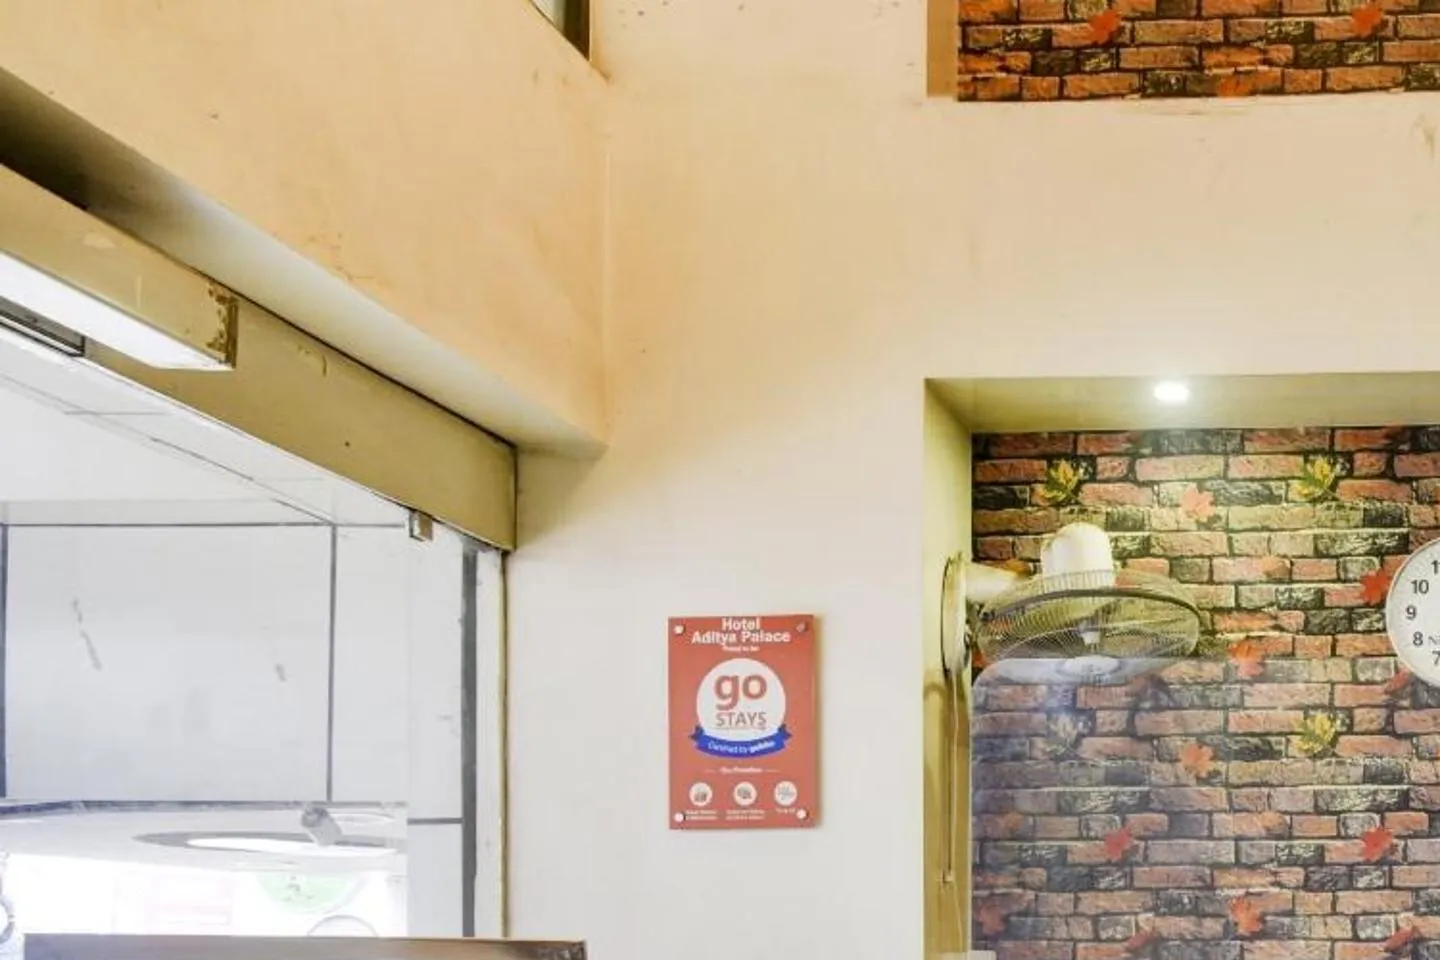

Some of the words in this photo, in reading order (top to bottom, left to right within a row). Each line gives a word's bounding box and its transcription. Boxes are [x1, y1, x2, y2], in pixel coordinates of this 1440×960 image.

[1412, 579, 1429, 594] 10
[1406, 605, 1417, 620] 9
[721, 617, 761, 632] Hotel
[691, 631, 737, 646] Aditya
[742, 630, 792, 643] Palace
[1412, 631, 1423, 646] 8
[714, 674, 768, 711] go
[716, 711, 768, 727] STAYS
